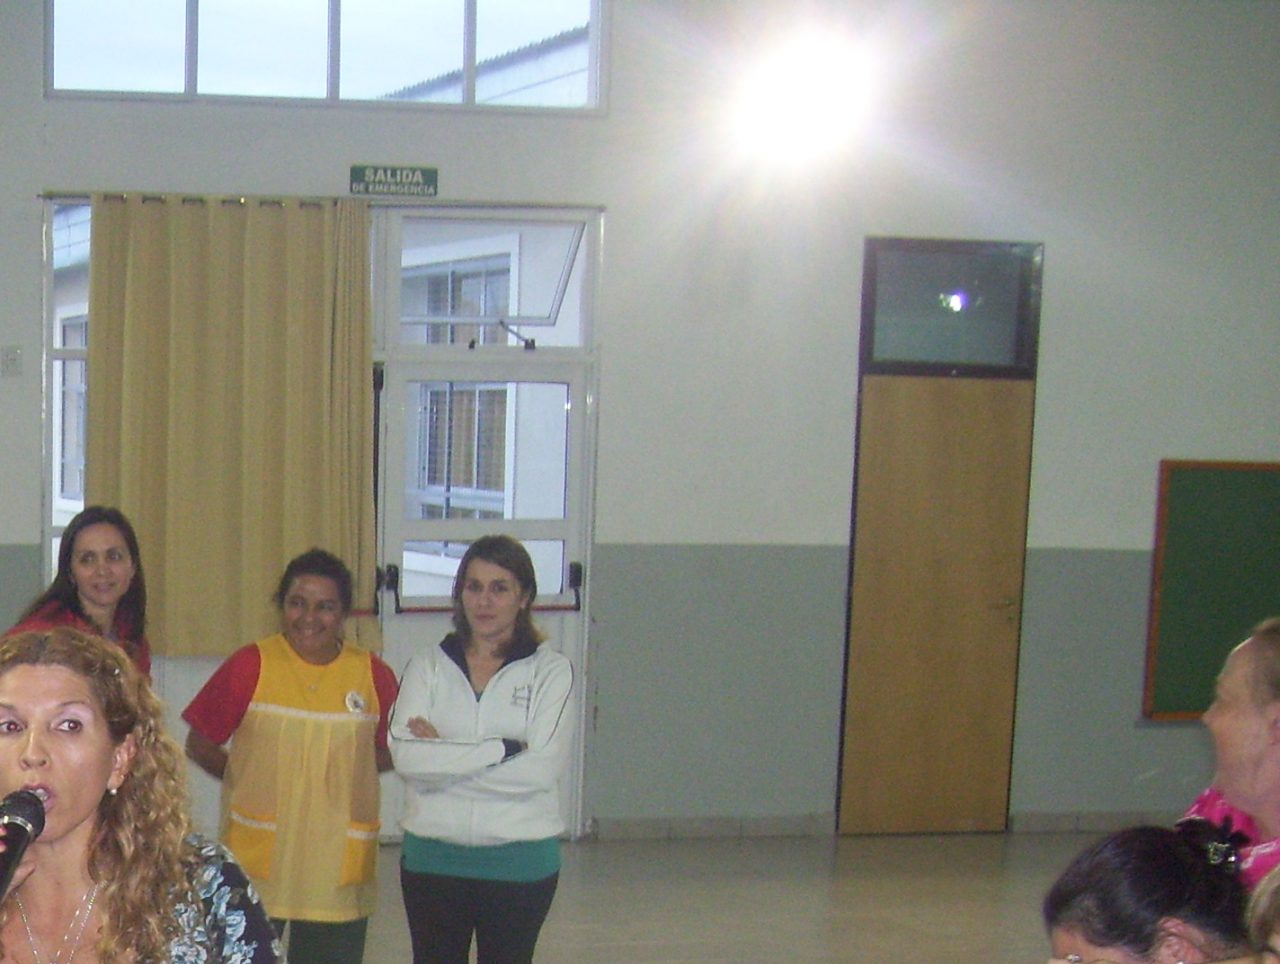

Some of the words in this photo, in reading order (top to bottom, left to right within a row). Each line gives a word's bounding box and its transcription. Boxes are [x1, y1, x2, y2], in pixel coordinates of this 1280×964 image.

[364, 167, 424, 184] SALIDA
[352, 183, 367, 193] DE
[369, 184, 435, 195] EMERGENCIA
